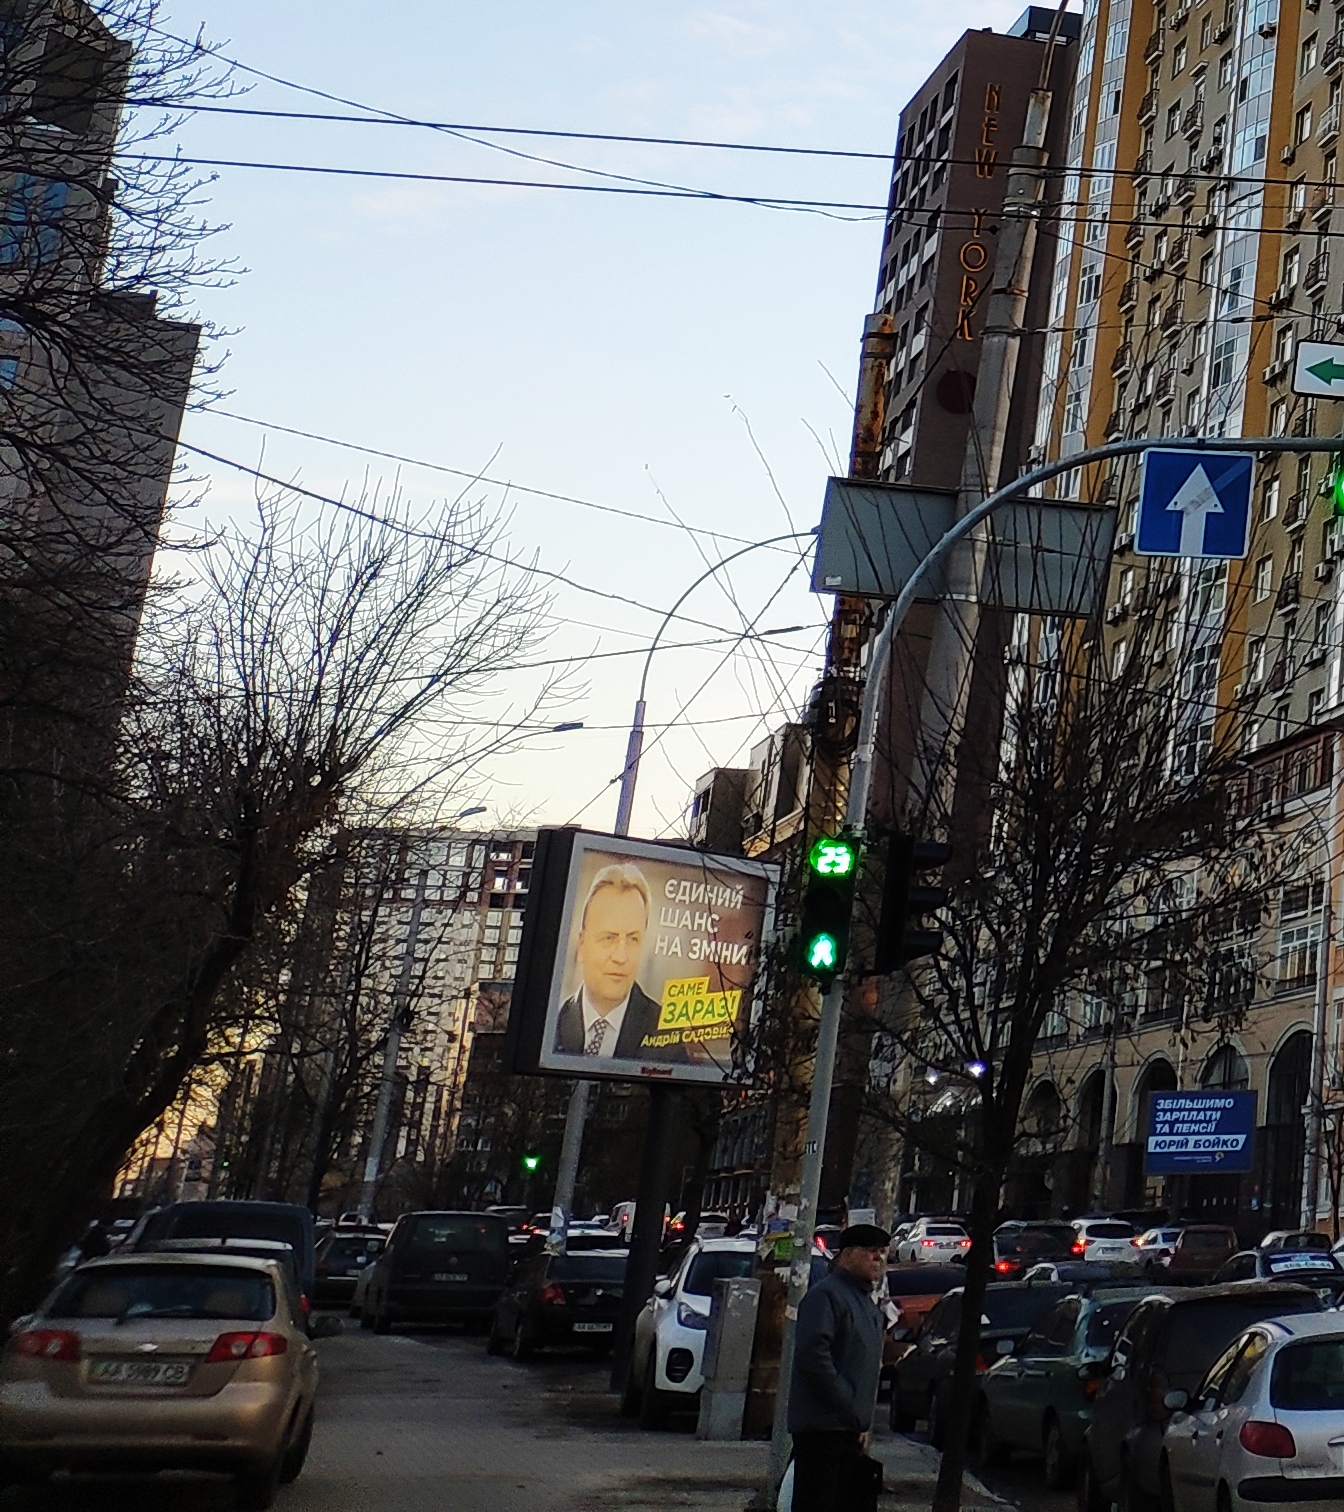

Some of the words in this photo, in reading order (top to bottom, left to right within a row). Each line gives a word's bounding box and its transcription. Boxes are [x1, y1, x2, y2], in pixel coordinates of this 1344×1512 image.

[975, 82, 1001, 178] NEW
[957, 207, 988, 341] YORK
[664, 879, 744, 910] ЄДИНИЙ
[660, 906, 720, 933] ШАНС
[654, 936, 682, 957] НА
[688, 939, 749, 966] ЗМІНИ
[667, 981, 704, 998] САМЕ
[662, 994, 737, 1025] ЗАРАЗ!
[1155, 1098, 1235, 1109] ЗБІЛЬШИМО
[1155, 1110, 1222, 1121] ЗАРПЛАТИ
[1154, 1123, 1170, 1134] ТА
[1172, 1120, 1218, 1133] ПЕНСІЇ
[1153, 1137, 1190, 1150] ЮРІЙ
[1192, 1136, 1240, 1149] БОЙКО
